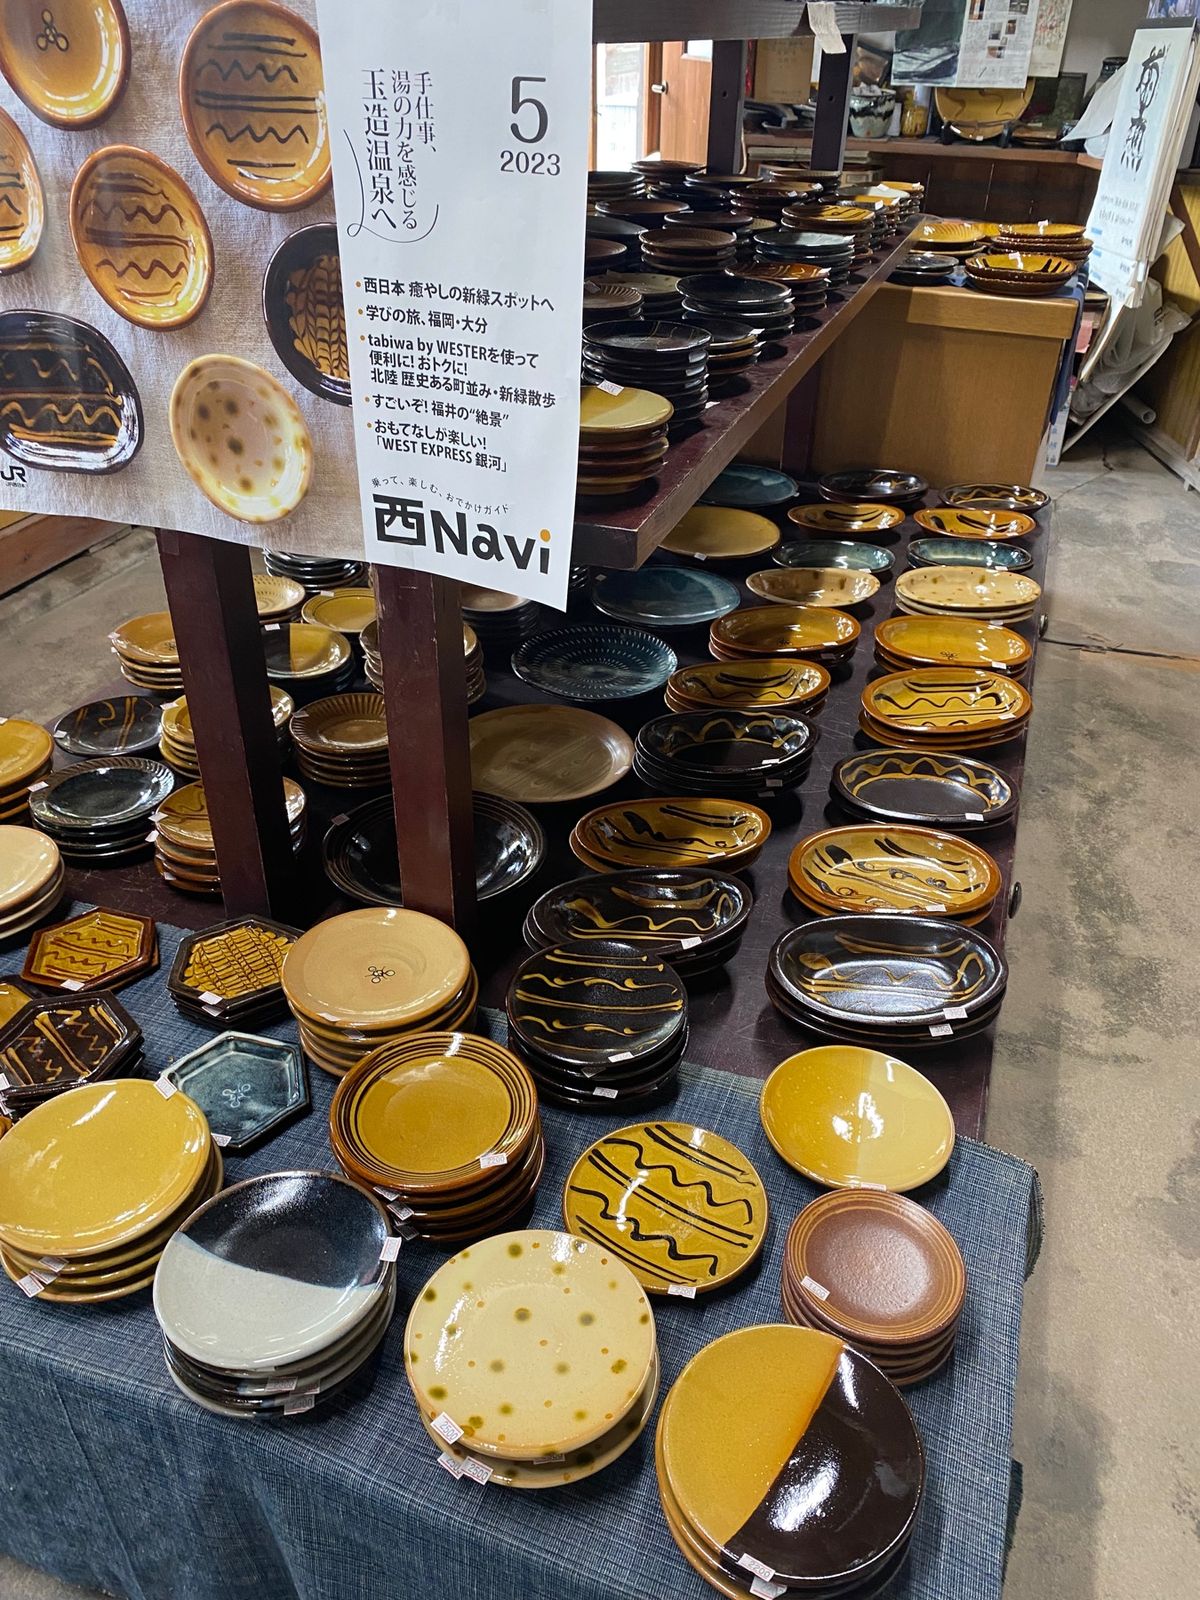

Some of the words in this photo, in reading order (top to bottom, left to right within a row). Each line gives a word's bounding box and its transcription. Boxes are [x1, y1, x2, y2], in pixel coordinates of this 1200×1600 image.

[413, 71, 437, 152] 手仕事、
[510, 76, 549, 143] 5
[361, 68, 397, 230] 玉造温泉へ
[391, 69, 418, 230] 湯の力を感じる
[500, 150, 561, 176] 2023
[363, 276, 406, 296] 西日本
[408, 280, 555, 312] 癒やしの新緑スポットへ
[365, 304, 488, 334] 学びの旅、福岡・大分
[367, 333, 414, 351] tabiwa
[417, 335, 434, 356] by
[436, 339, 539, 369] WESTERを使って
[370, 367, 399, 386] 北陸
[401, 371, 556, 409] 歴史ある町並み・新緑散歩
[421, 441, 472, 465] EXPRESS
[0, 465, 27, 483] JR
[372, 493, 552, 575] 西Navi
[439, 1420, 459, 1439] 2500
[467, 1463, 489, 1481] 2500
[748, 1560, 771, 1577] 2200
